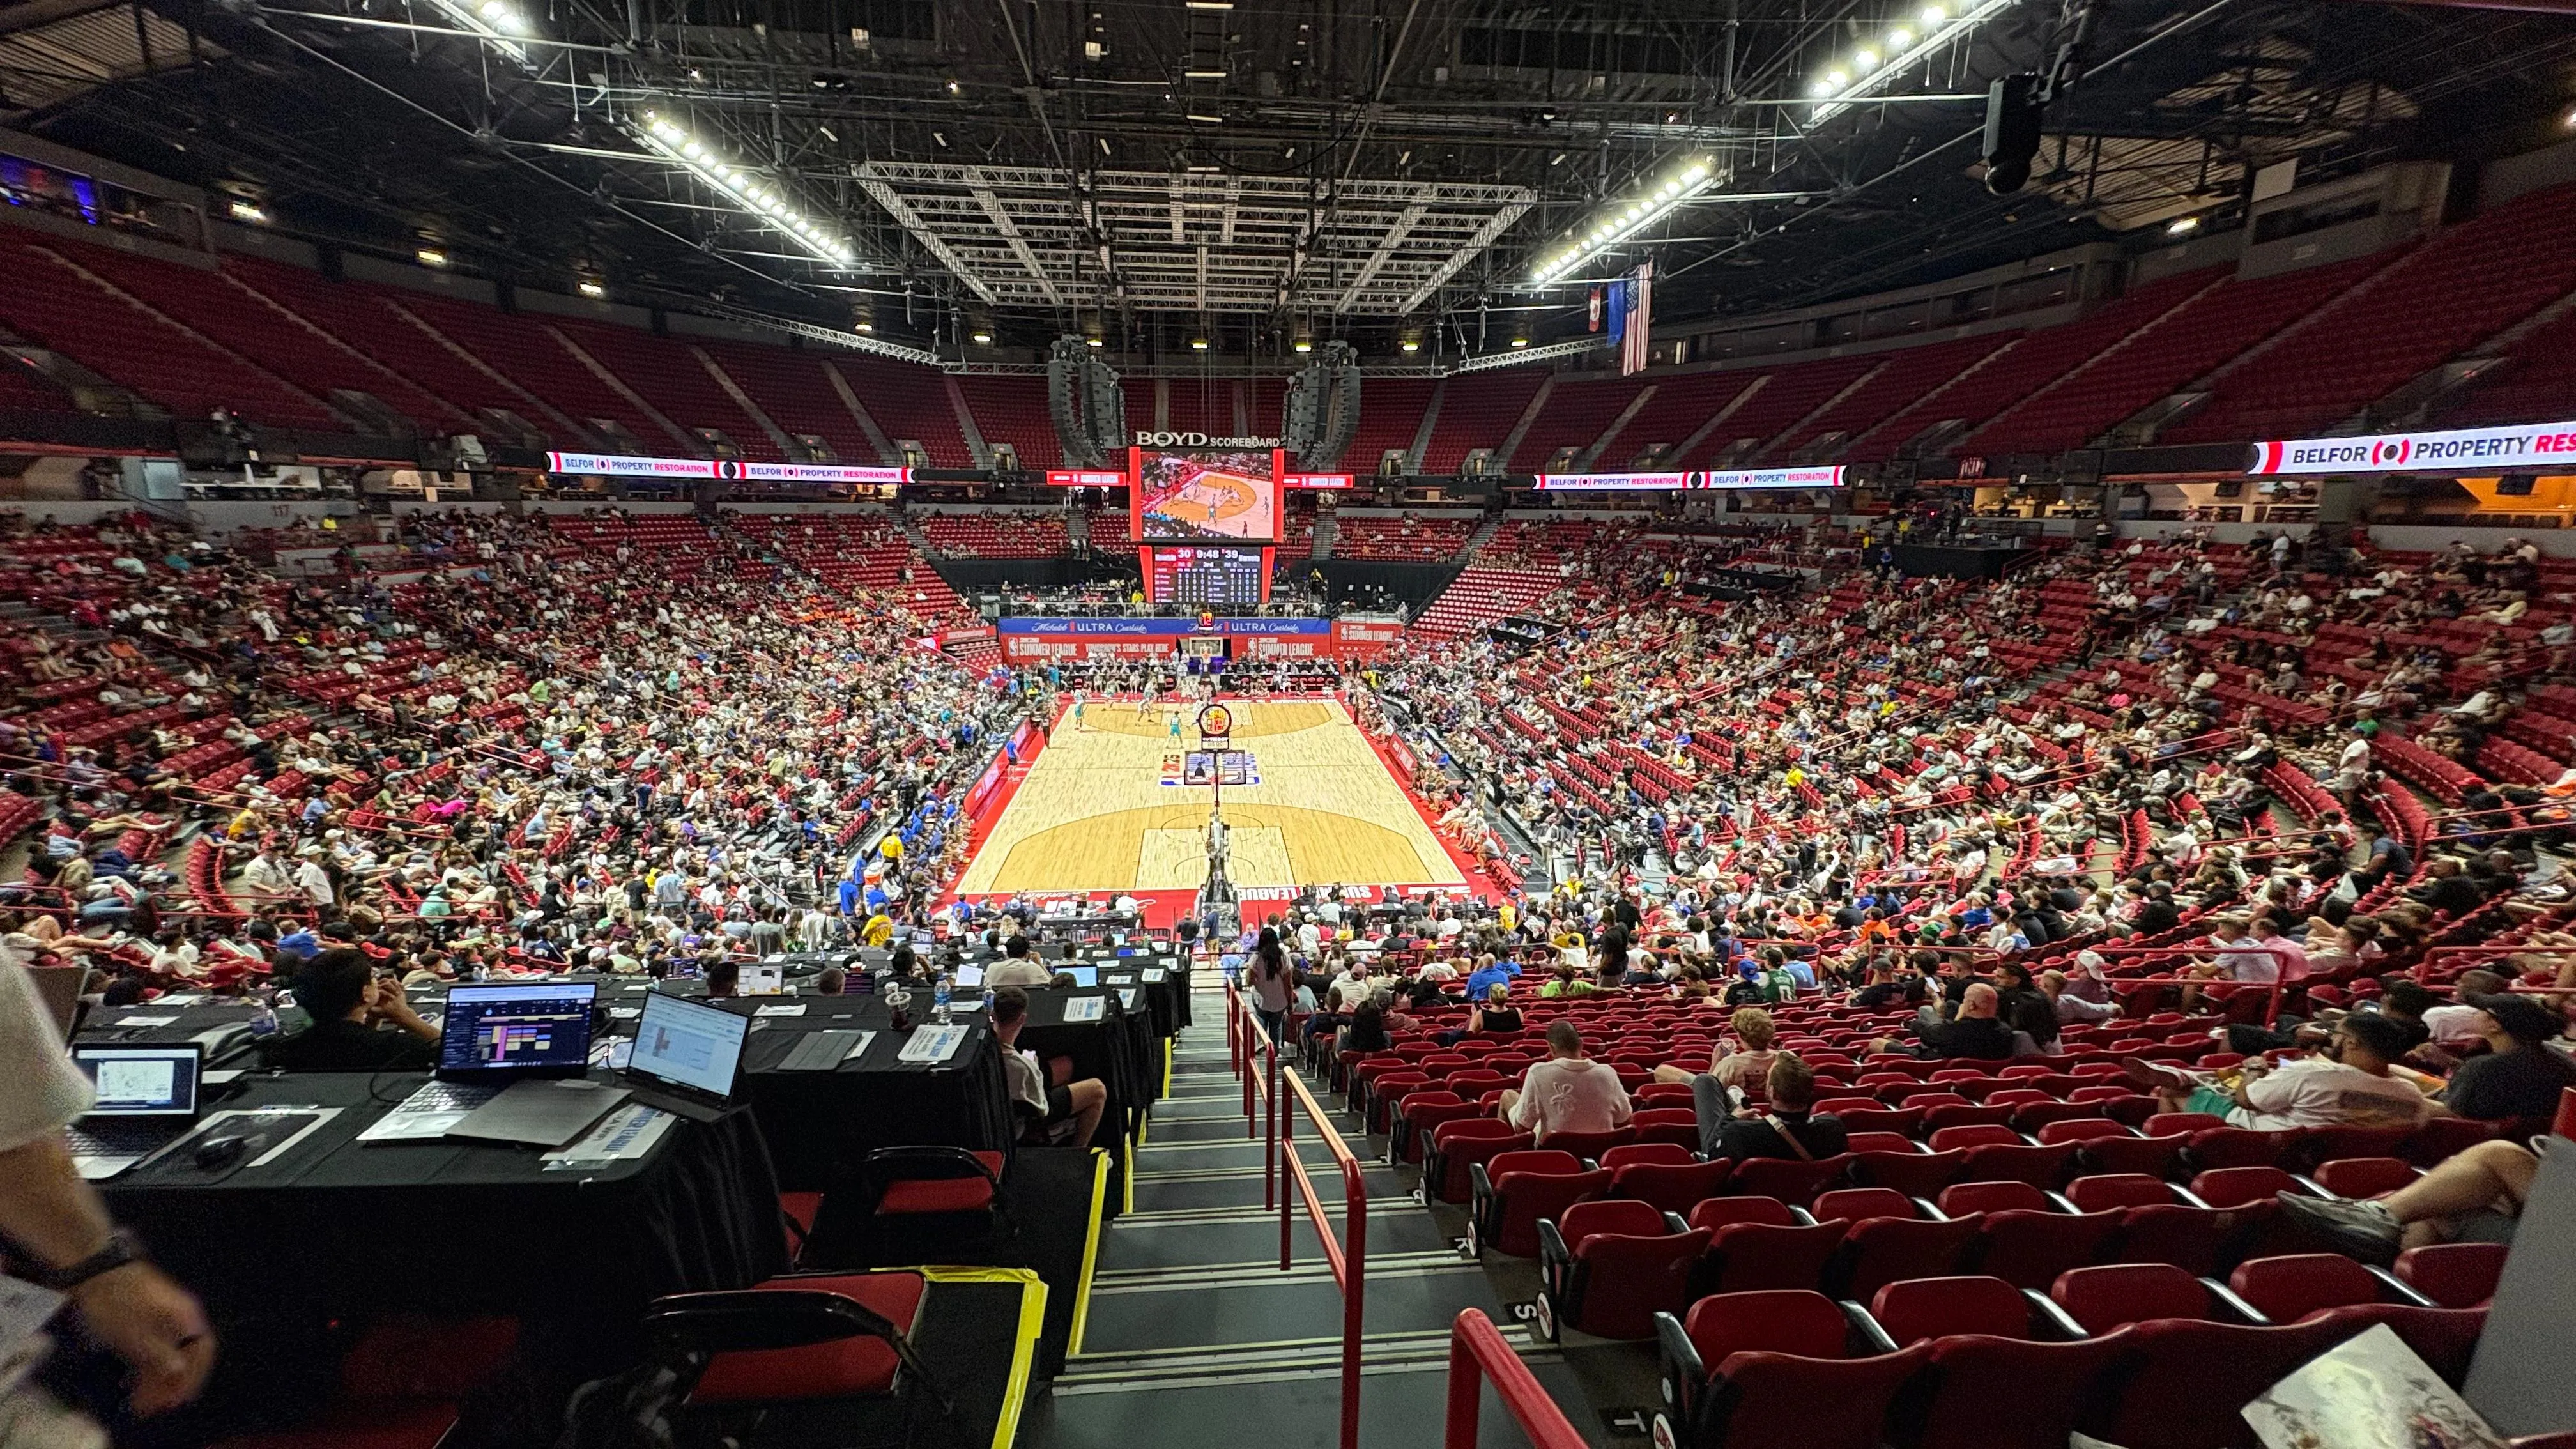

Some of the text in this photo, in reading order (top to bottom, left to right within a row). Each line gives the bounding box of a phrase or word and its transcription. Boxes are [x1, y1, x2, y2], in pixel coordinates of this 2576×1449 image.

[1136, 431, 1280, 447] BOYD SCOREBOARD
[2292, 447, 2368, 464] BELFOR
[2414, 436, 2532, 459] PROPERTY
[565, 458, 709, 473] BELFOR PROPERTY RESTORATION
[751, 468, 896, 479] BELFOR PROPERTY RESTORATION
[1714, 471, 1830, 484] BELFOR PROPERTY RESTORATION
[1593, 477, 1630, 486] PROPERTY
[1178, 549, 1192, 559] 30
[1196, 550, 1220, 559] 9:48
[1225, 550, 1238, 559] 39
[1077, 623, 1113, 632] ULTRA
[1231, 623, 1266, 632] ULTRA
[1349, 630, 1373, 641] SUMMER
[1019, 643, 1077, 656] SUMMER LEAGUE
[1258, 643, 1314, 656] SUMMER LEAGUE
[1238, 887, 1299, 900] LEAGUE
[1514, 1304, 1537, 1319] S
[1614, 1411, 1646, 1432] T
